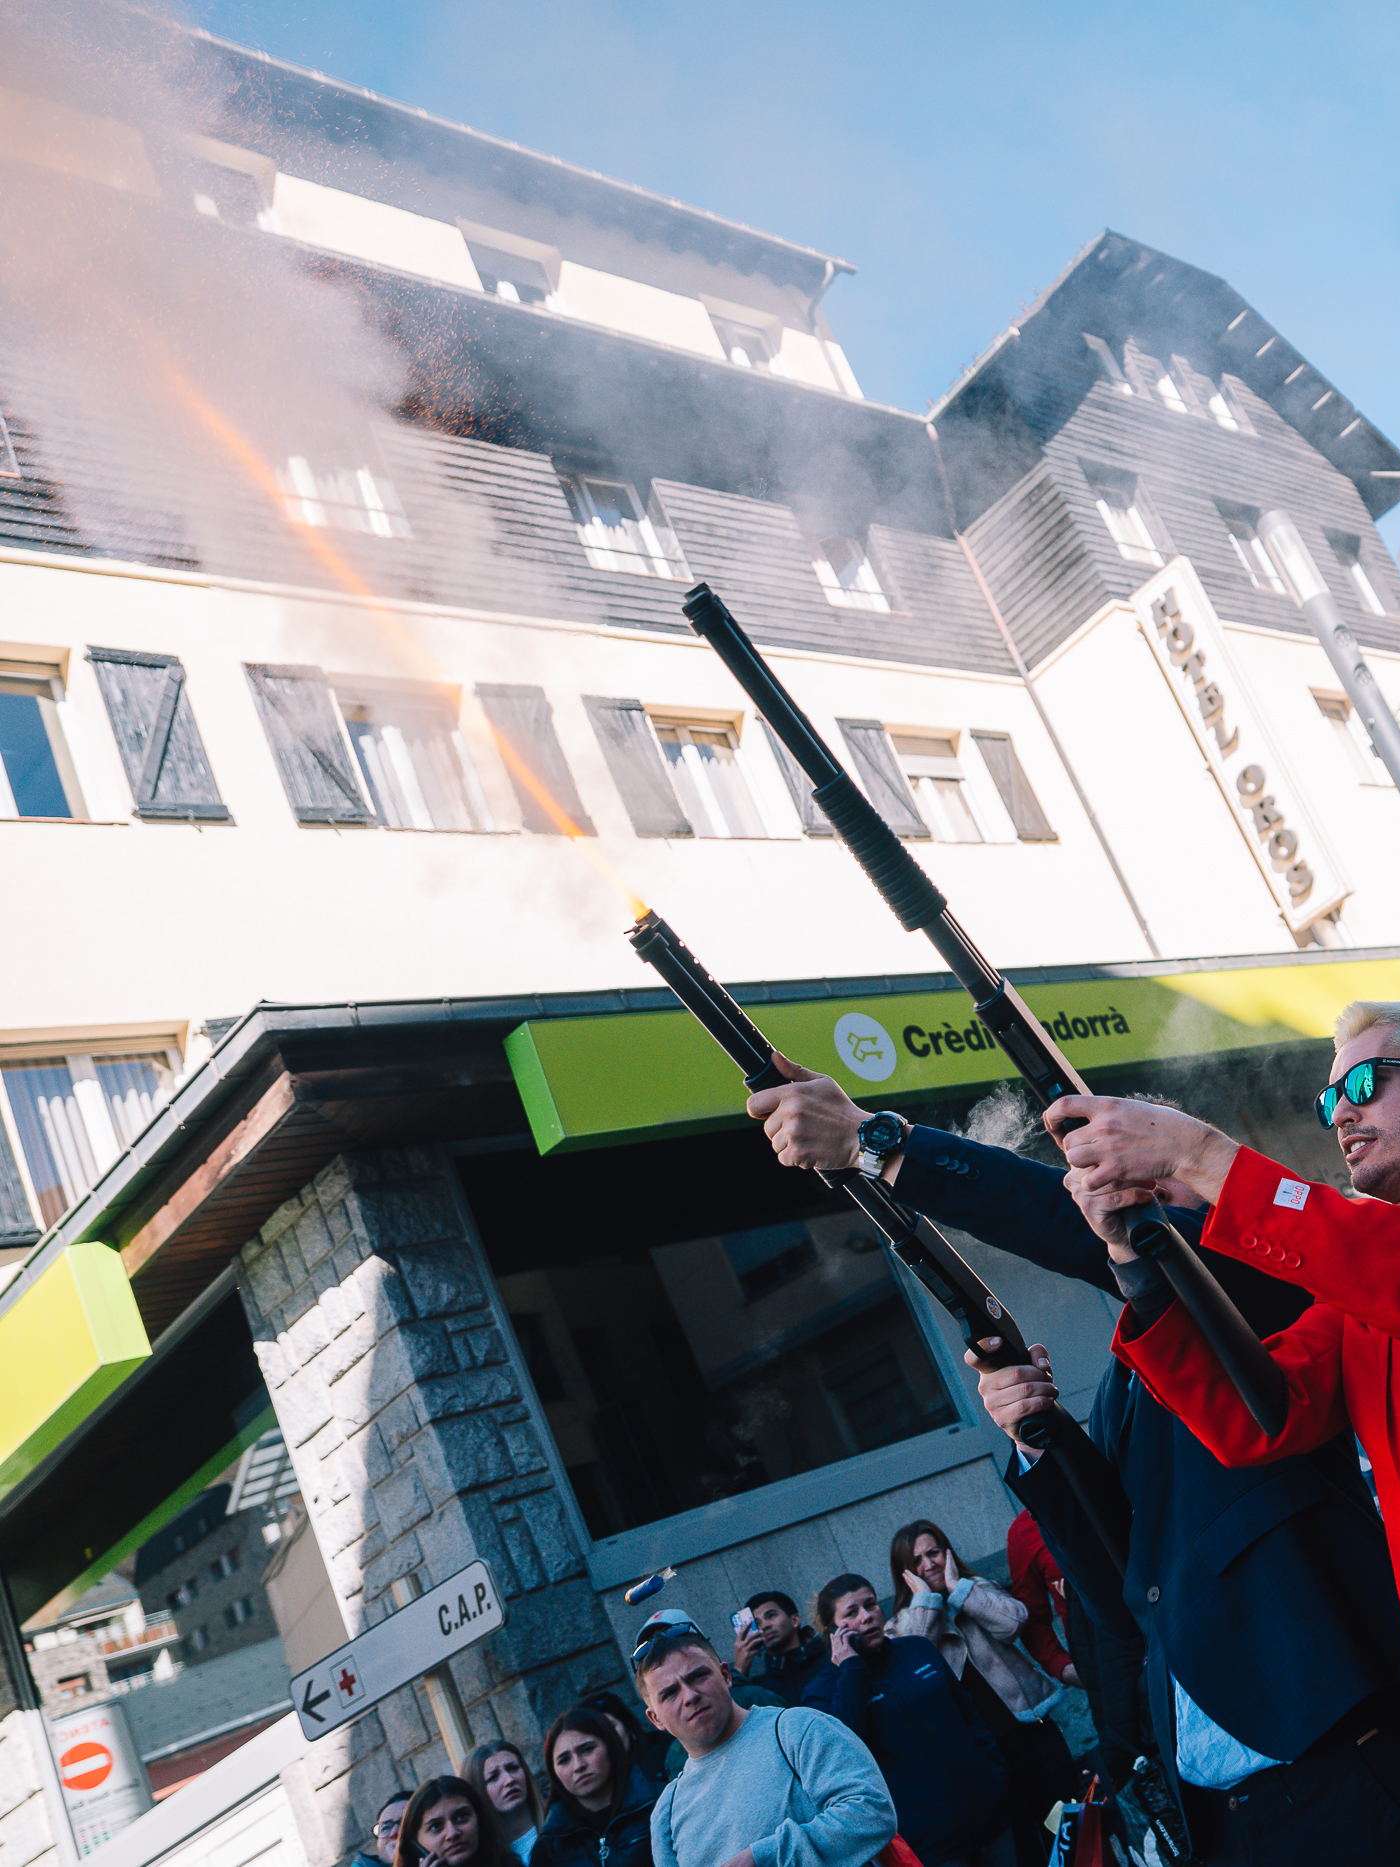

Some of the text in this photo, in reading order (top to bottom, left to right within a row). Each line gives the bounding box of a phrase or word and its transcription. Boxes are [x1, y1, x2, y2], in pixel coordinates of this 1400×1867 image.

[1150, 586, 1315, 908] HOTEL OROS
[902, 1006, 1131, 1058] Crèdi ndorrà
[1290, 1185, 1305, 1205] OPPO
[438, 1582, 492, 1636] C.A.P.
